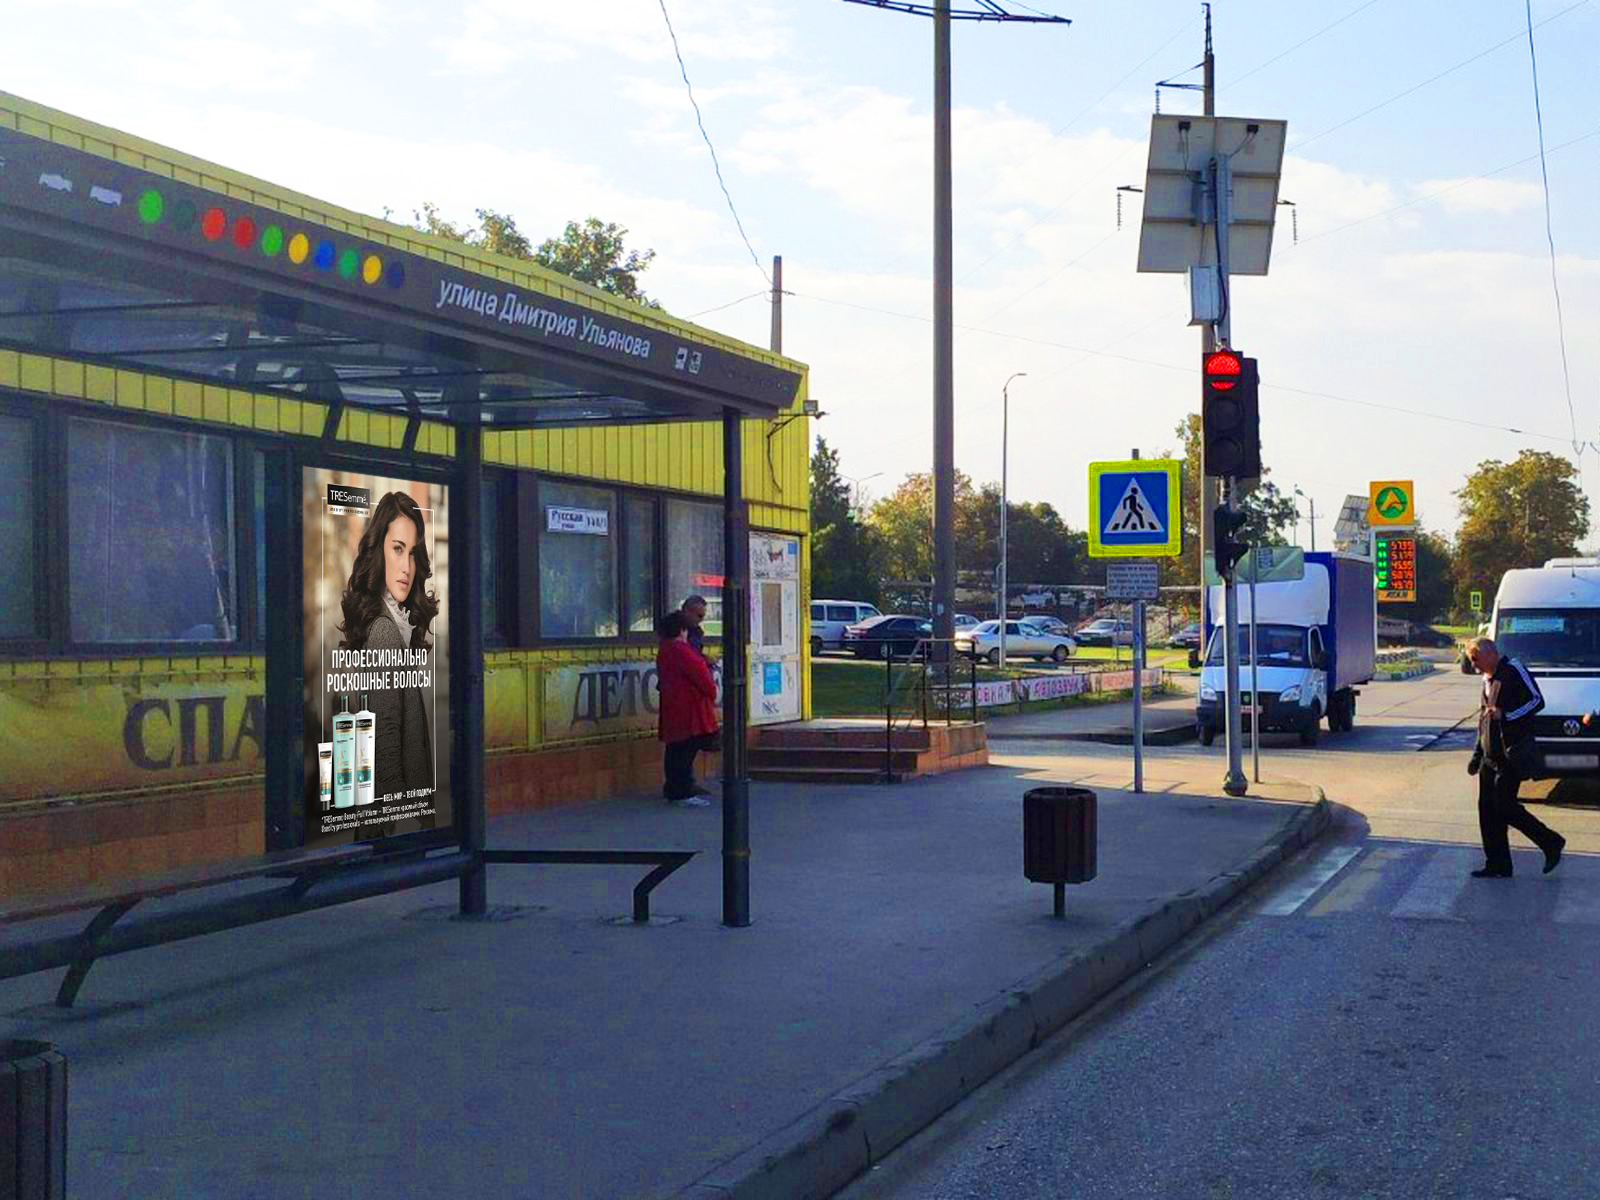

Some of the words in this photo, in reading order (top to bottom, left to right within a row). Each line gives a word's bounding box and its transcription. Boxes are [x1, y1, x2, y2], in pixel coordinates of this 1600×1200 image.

[436, 279, 498, 316] улица
[499, 292, 577, 337] Дмитрия
[579, 315, 651, 359] Ульянова
[331, 648, 428, 669] ПРОФЕССИОНАЛЬНО
[327, 671, 391, 693] РОСКОШНЫЕ
[393, 669, 432, 689] ВОЛОСЫ
